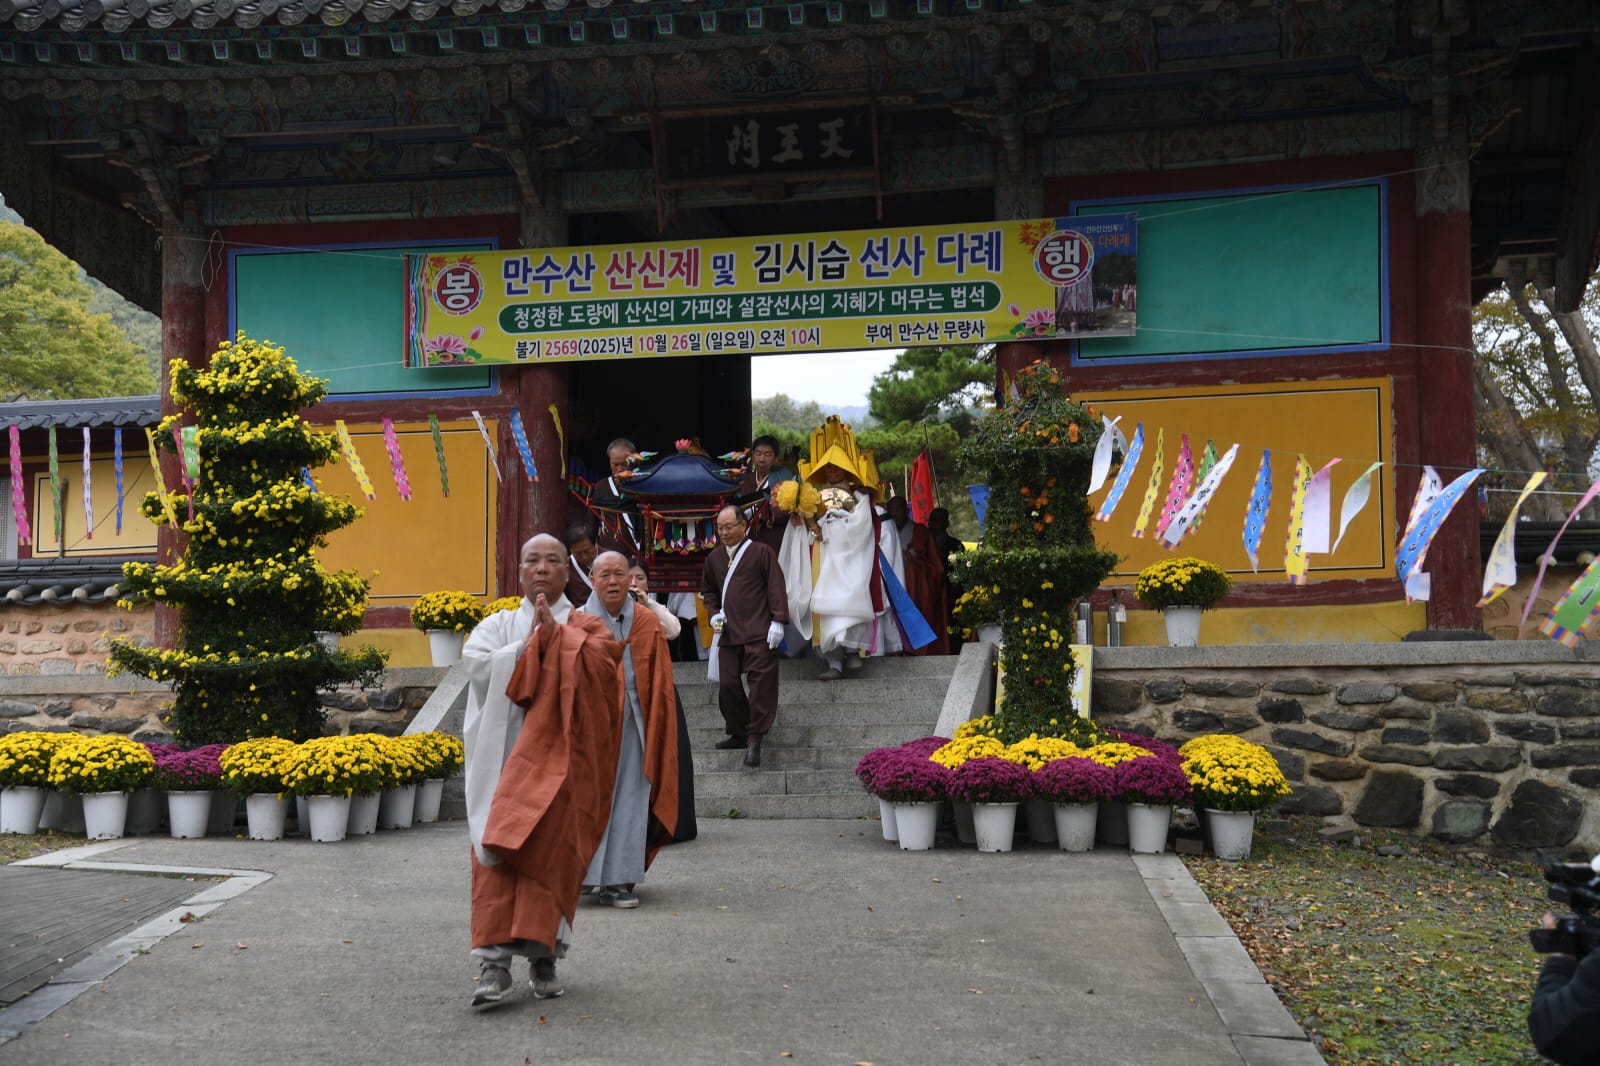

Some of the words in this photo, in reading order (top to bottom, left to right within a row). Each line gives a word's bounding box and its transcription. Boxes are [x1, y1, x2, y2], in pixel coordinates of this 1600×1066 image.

[503, 253, 596, 296] 만수산
[605, 247, 700, 290] 산신제
[712, 253, 736, 287] 및
[753, 240, 850, 284] 김시습
[859, 235, 926, 279] 선사
[936, 230, 1001, 275] 다례
[1043, 239, 1081, 279] 행
[441, 270, 475, 309] 봉
[514, 306, 564, 330] 청정한
[567, 302, 619, 325] 도량에
[624, 299, 675, 324] 산신의
[681, 297, 734, 321] 가피와
[738, 292, 825, 319] 설잠선사의
[831, 289, 885, 314] 지혜가
[891, 287, 945, 312] 머무는
[951, 284, 986, 309] 법석
[515, 340, 542, 359] 불기
[544, 335, 634, 357] 2569(2025)년
[637, 334, 667, 353] 10월
[671, 332, 701, 351] 26일
[705, 330, 756, 350] (일요일)
[758, 328, 786, 347] 오전
[790, 327, 820, 346] 10시
[865, 322, 893, 343] 부여
[898, 321, 940, 342] 만수산
[943, 319, 986, 339] 무량사
